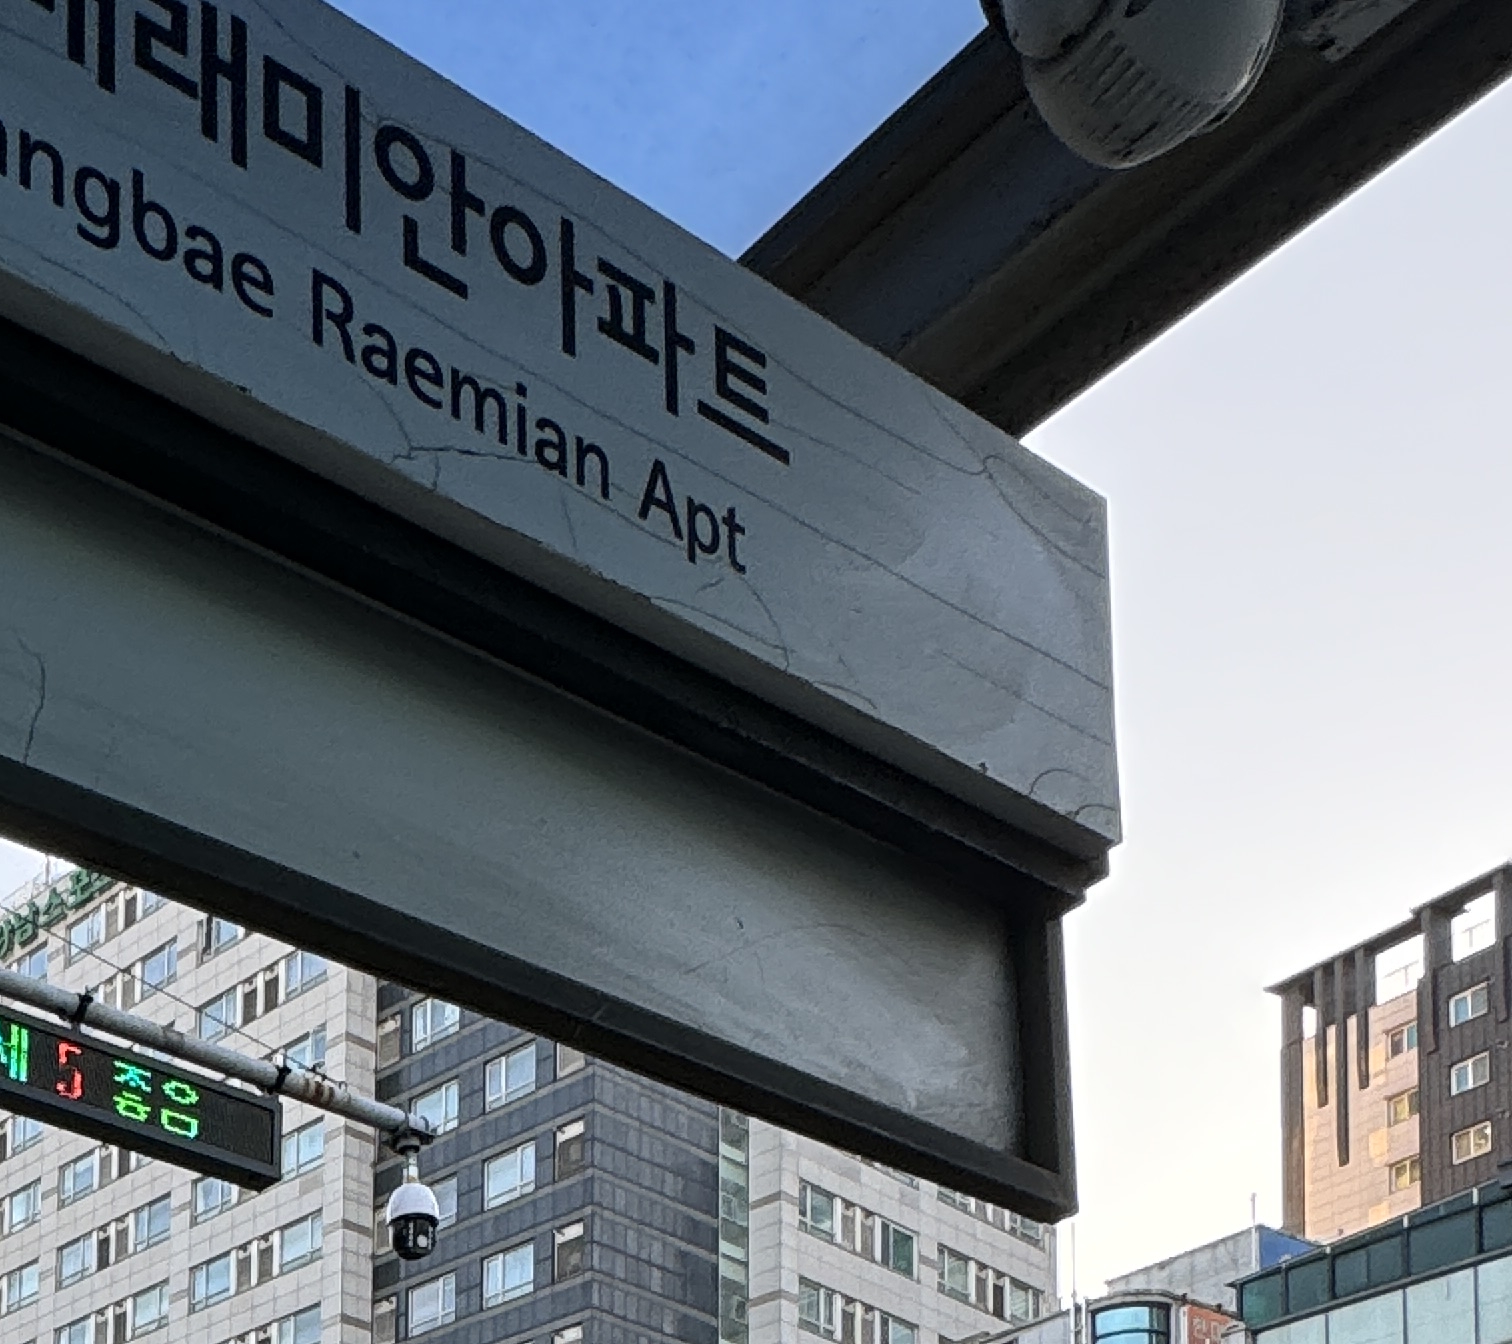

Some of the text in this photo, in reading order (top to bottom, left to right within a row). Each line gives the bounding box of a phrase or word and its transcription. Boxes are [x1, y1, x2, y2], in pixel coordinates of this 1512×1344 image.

[33, 0, 790, 466] 래미안아파트
[310, 266, 612, 500] Raemian
[638, 458, 748, 577] Apt
[56, 1040, 85, 1100] 5
[112, 1059, 200, 1140] 좋음
